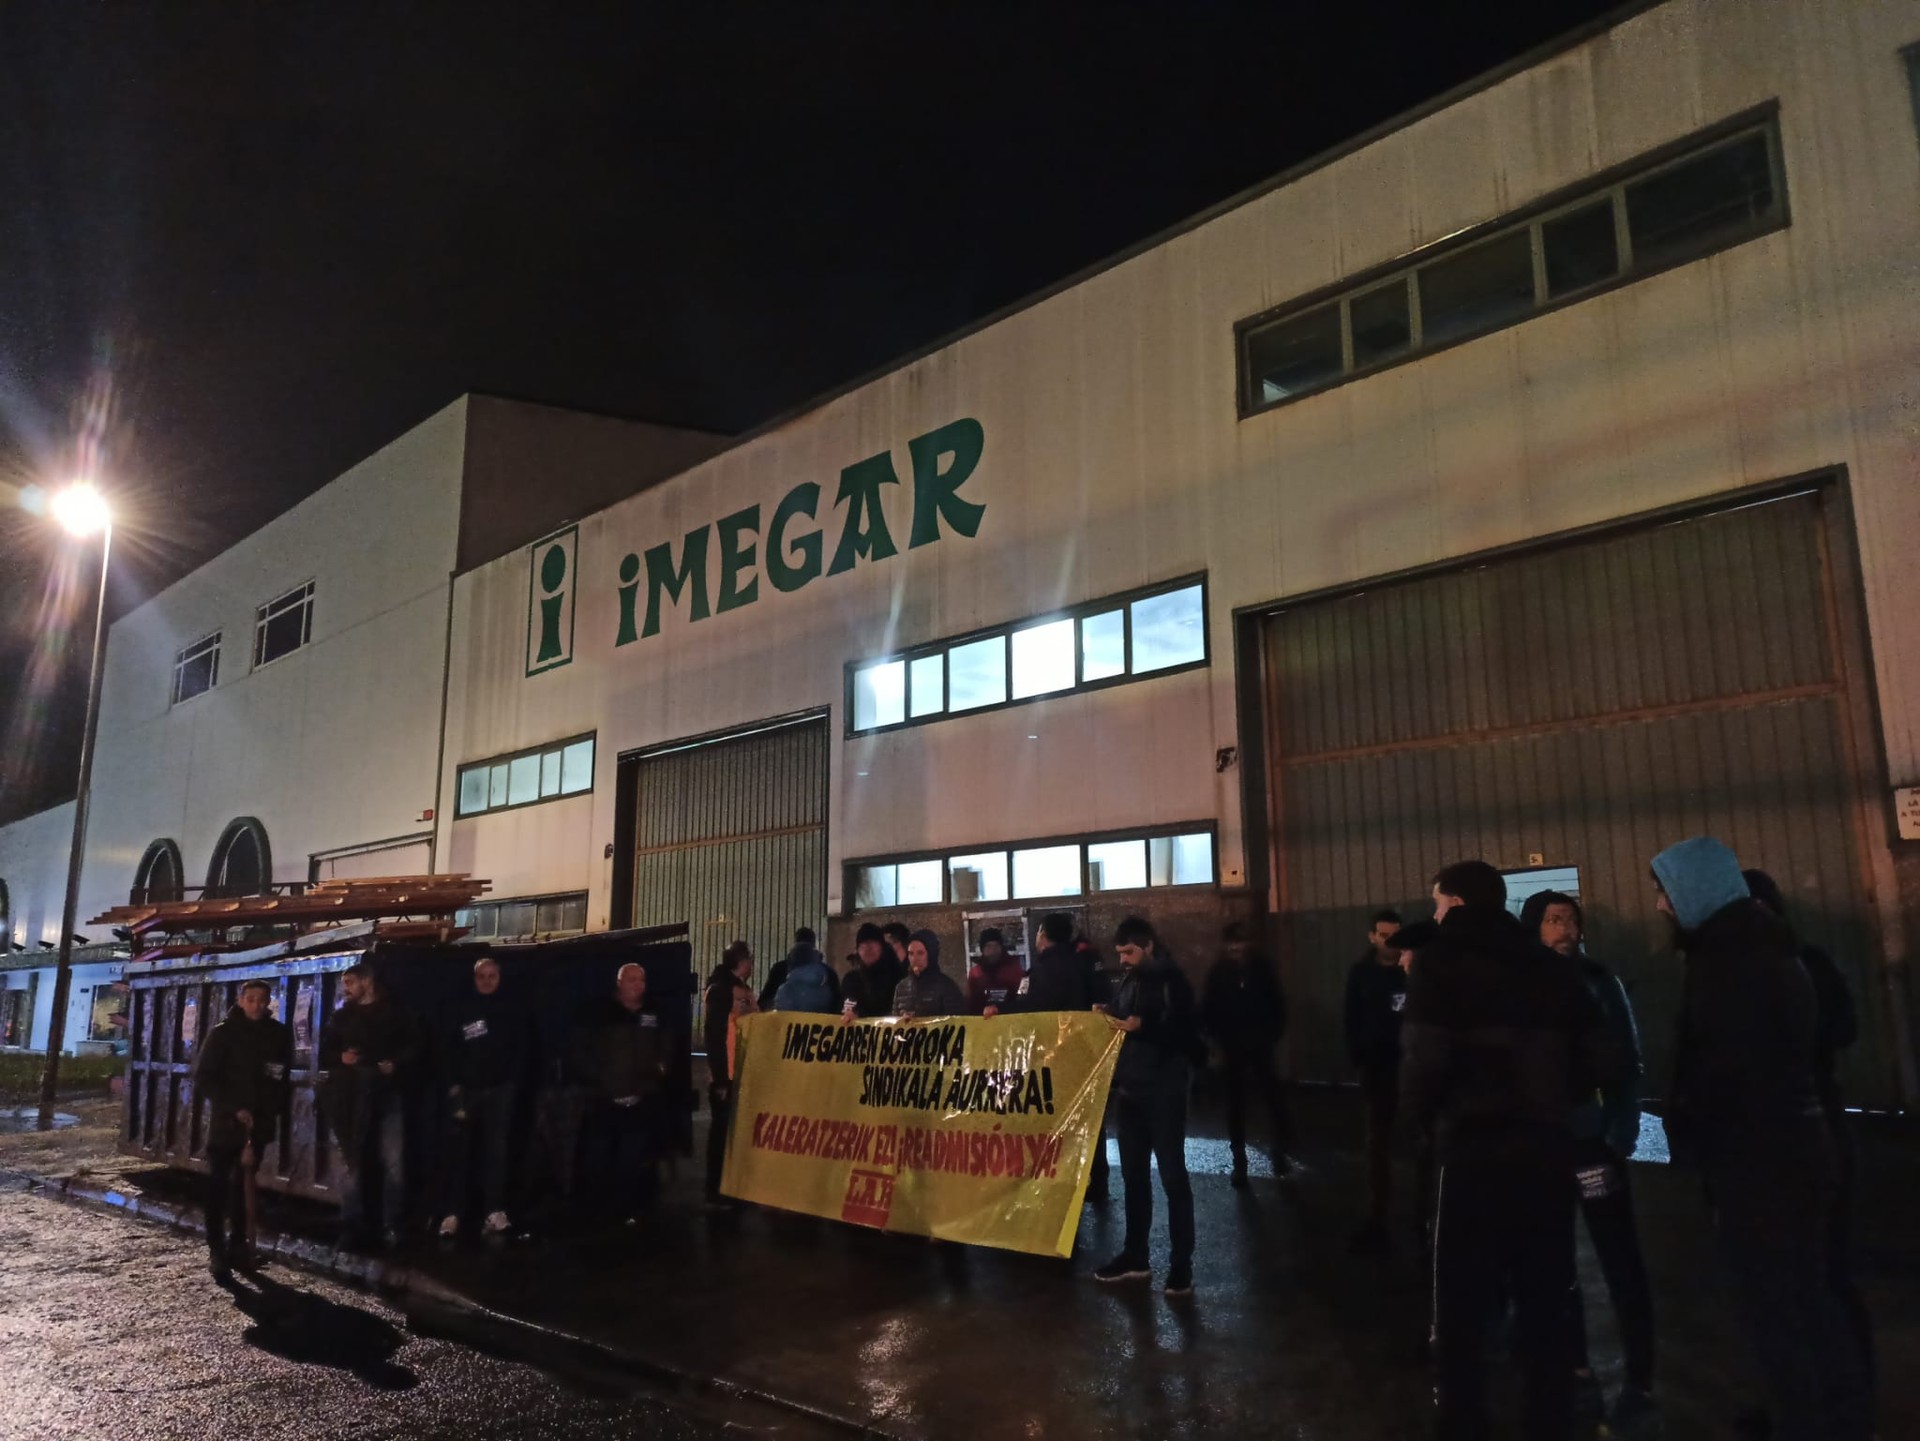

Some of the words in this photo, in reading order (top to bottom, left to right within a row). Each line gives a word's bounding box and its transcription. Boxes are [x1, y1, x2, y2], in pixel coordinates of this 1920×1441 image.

[782, 1023, 880, 1063] IMEGARREN
[879, 1025, 965, 1066] BORROKA
[859, 1065, 944, 1110] SINDIKALA
[943, 1066, 1055, 1115] AURRERA!
[752, 1112, 876, 1163] KALERATZERIK
